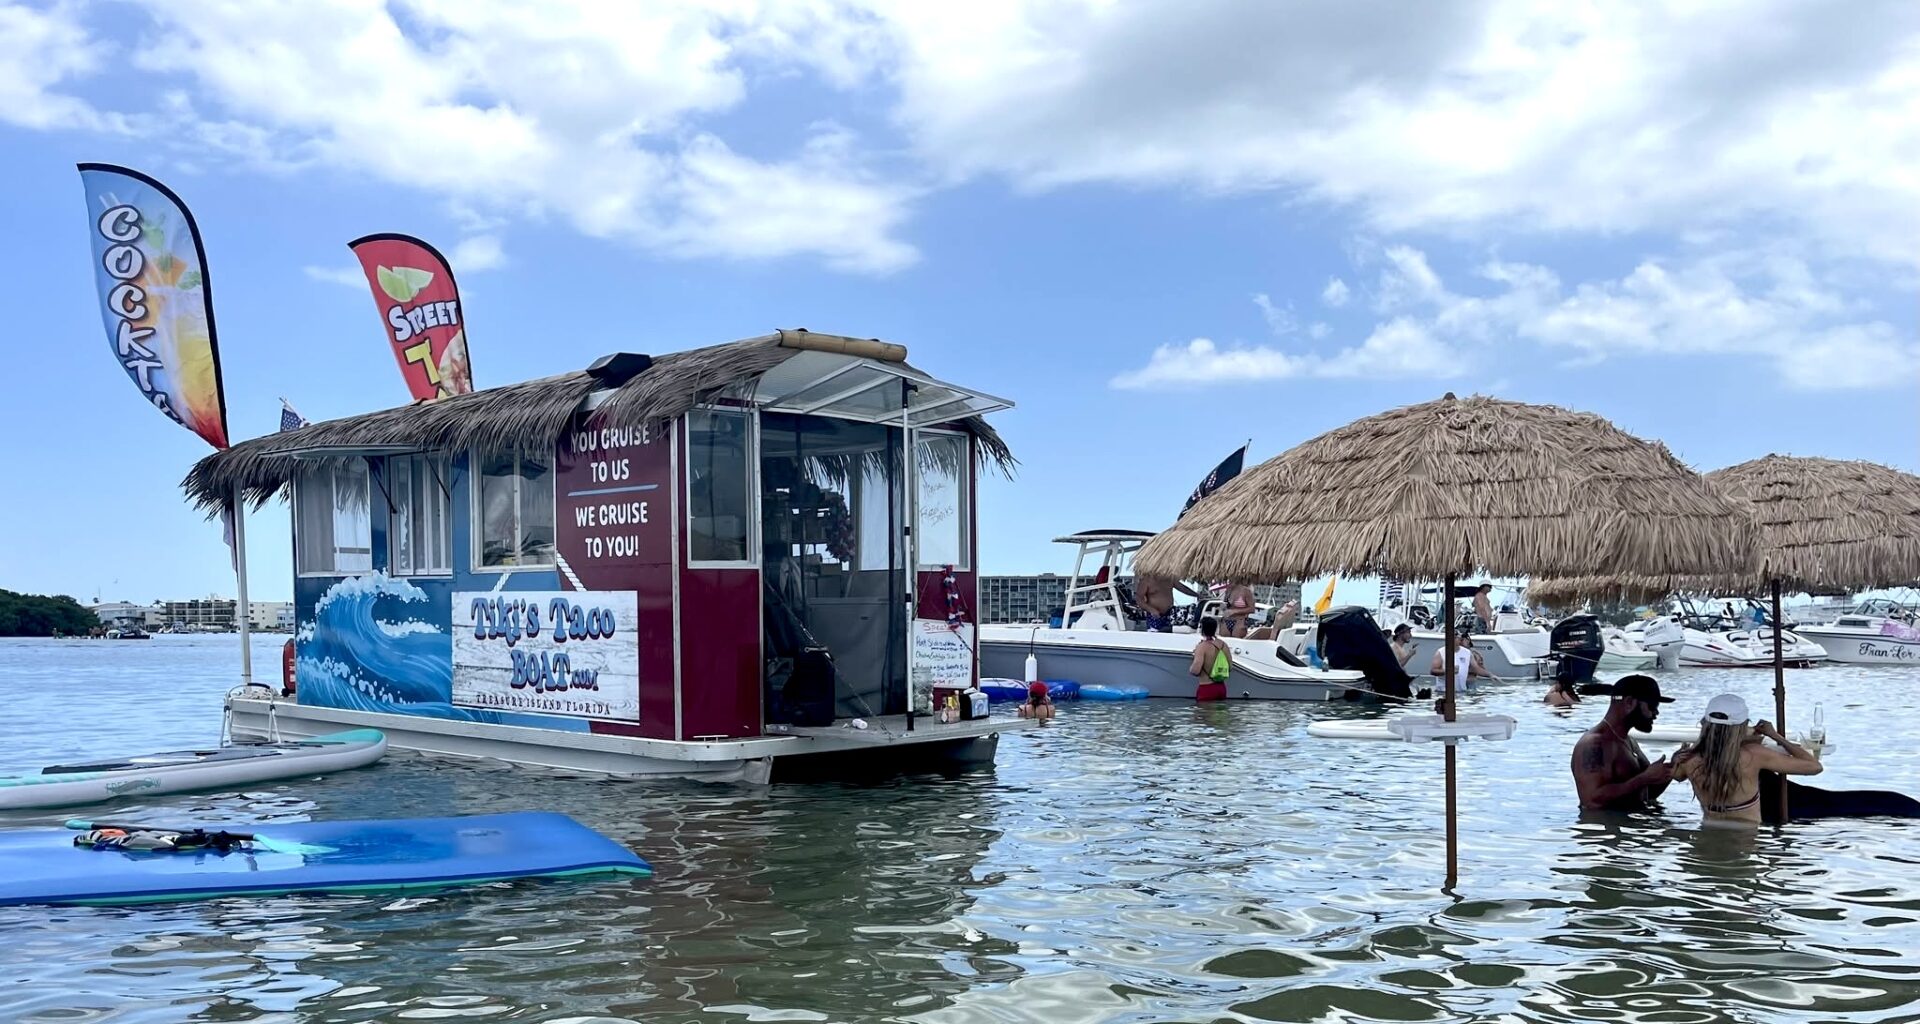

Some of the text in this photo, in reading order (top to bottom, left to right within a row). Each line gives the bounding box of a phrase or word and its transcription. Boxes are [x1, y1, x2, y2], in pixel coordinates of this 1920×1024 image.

[388, 301, 459, 342] STREET
[571, 424, 650, 453] YOU CRUISE
[591, 459, 630, 483] TO US
[575, 502, 648, 527] WE CRUISE
[585, 535, 639, 558] TO YOU!
[471, 595, 616, 647] Tiki's Taco
[476, 694, 523, 708] TREASURE
[566, 700, 611, 715] FLORIDA
